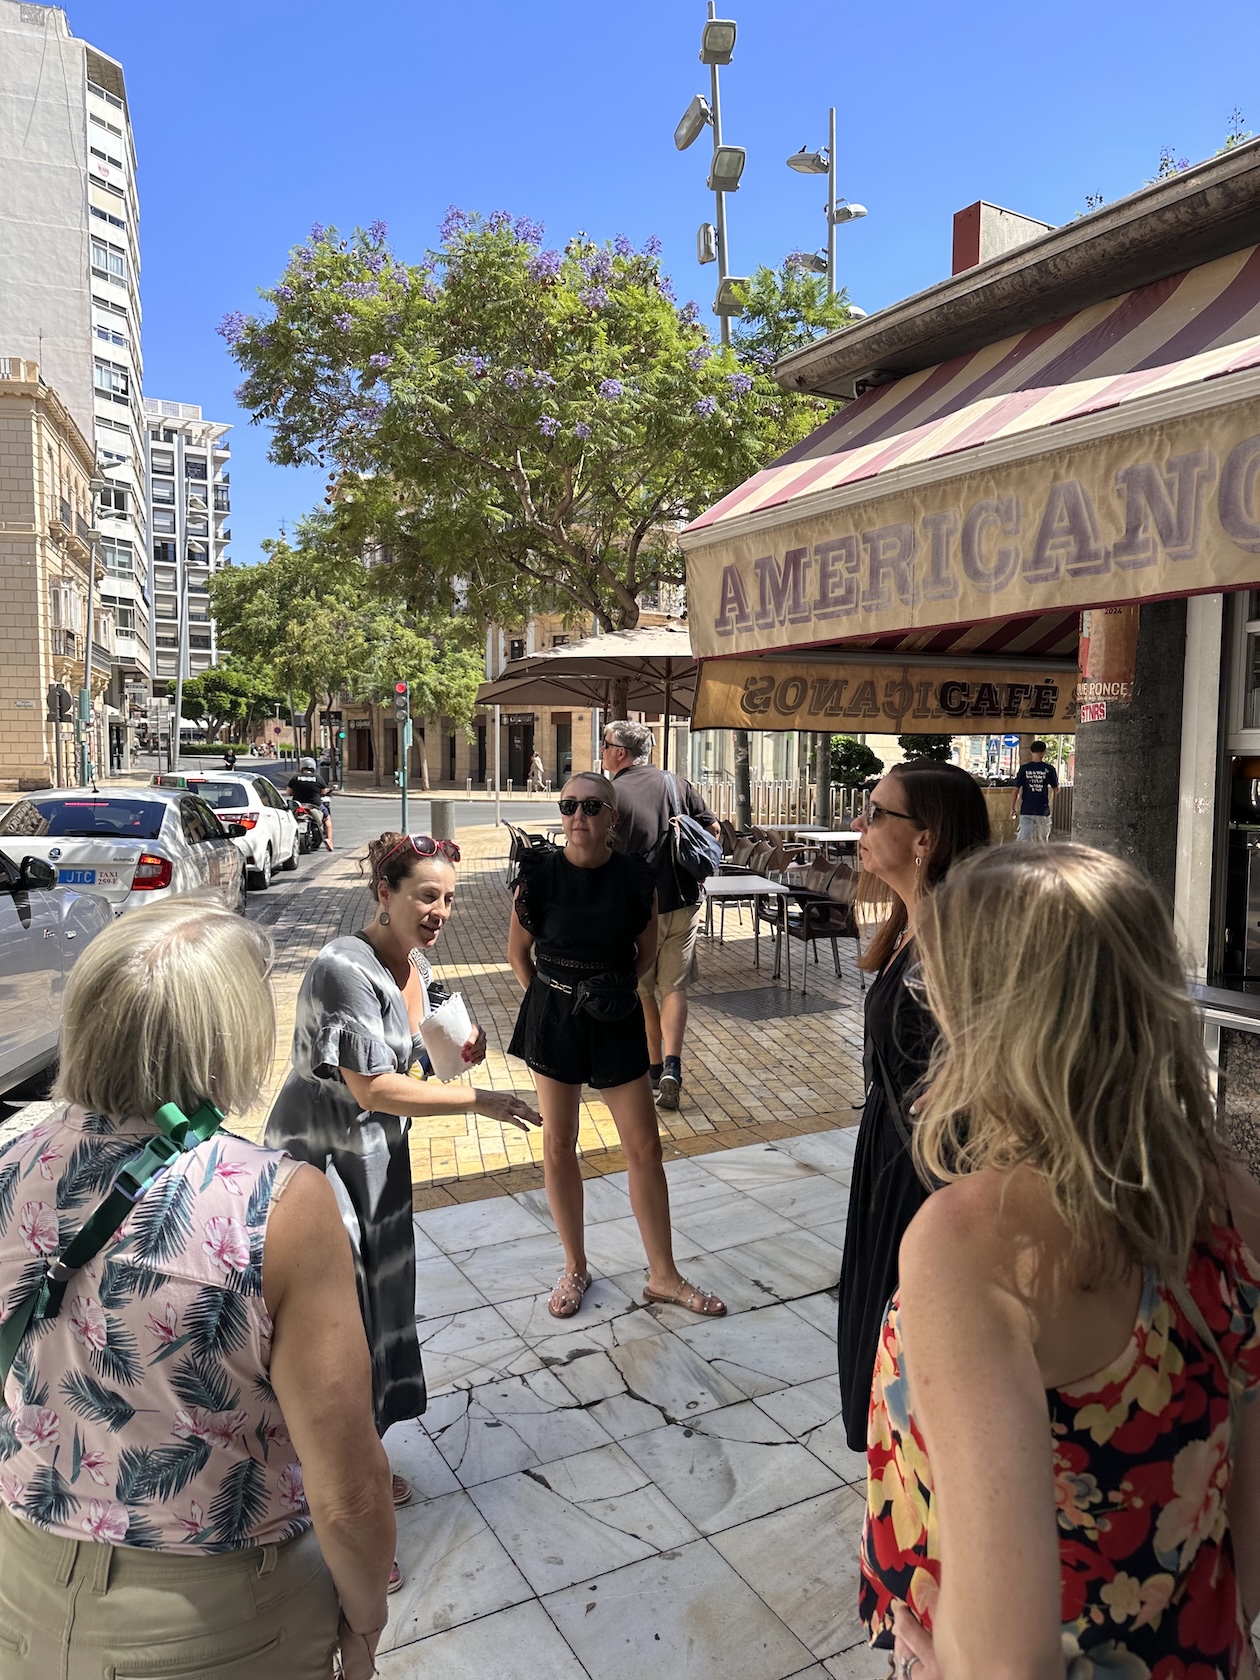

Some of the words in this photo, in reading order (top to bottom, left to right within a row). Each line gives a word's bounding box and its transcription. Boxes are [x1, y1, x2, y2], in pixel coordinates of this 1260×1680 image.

[1104, 607, 1122, 615] 2024
[1089, 682, 1128, 696] PONCE
[940, 678, 1058, 719] CAFÉ
[66, 871, 92, 883] JTC
